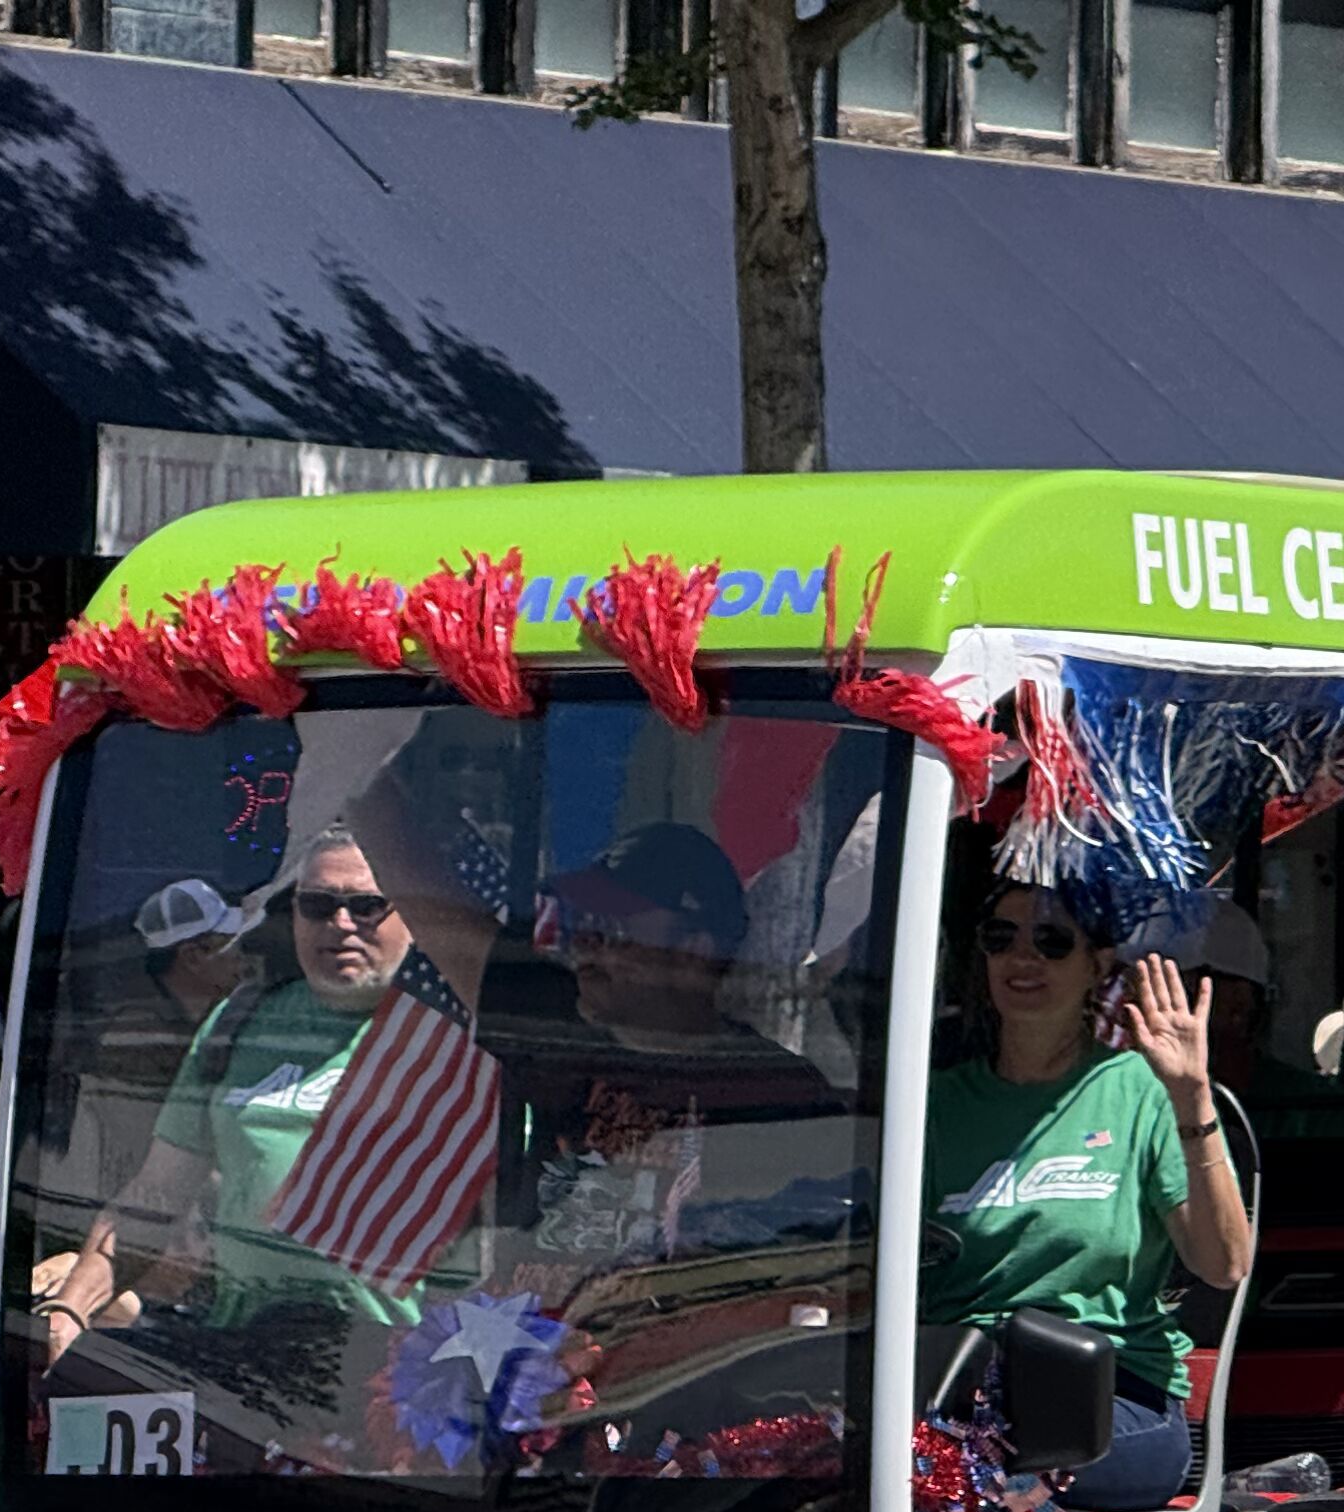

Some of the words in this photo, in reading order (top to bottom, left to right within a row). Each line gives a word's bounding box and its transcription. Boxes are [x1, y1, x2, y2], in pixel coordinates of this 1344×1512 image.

[1132, 513, 1269, 615] FUEL
[937, 1156, 1119, 1214] AC
[1046, 1171, 1121, 1184] TRANSIT
